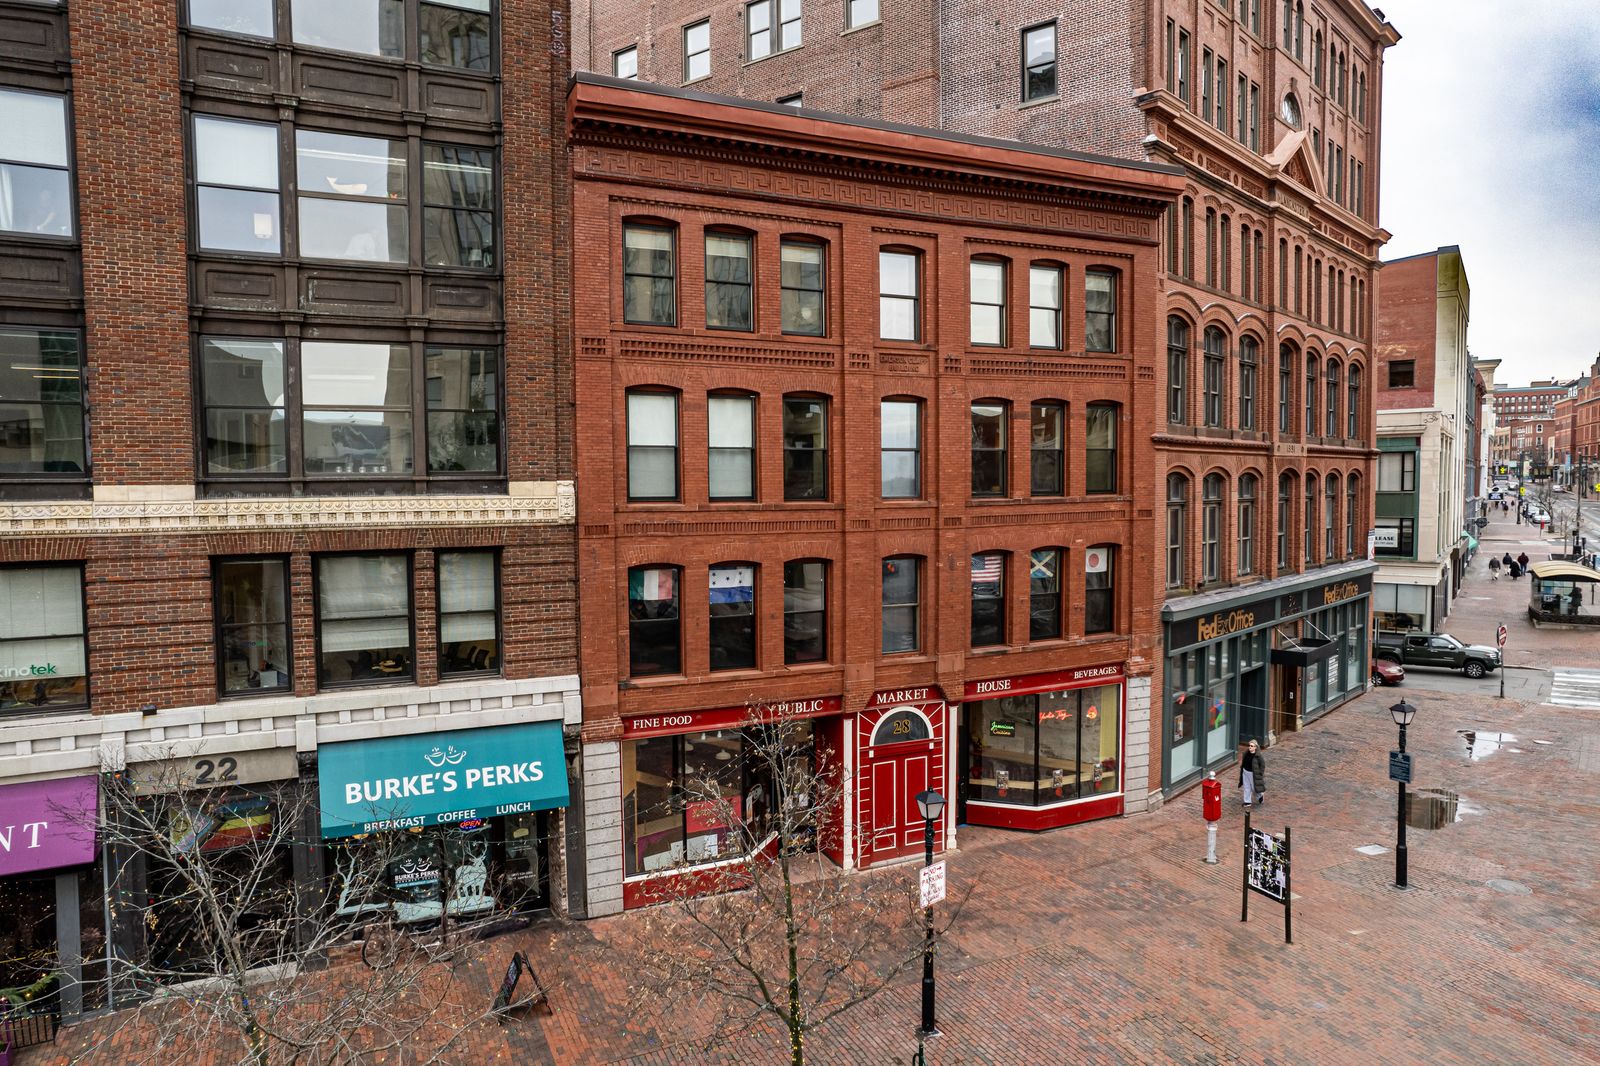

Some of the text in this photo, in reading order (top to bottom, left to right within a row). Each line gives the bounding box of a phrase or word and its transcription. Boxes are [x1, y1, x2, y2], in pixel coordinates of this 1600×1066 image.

[1228, 609, 1254, 632] Office
[1074, 666, 1117, 679] BEVERAGES
[976, 679, 1011, 693] HOUSE
[876, 688, 929, 704] MARKET
[778, 699, 824, 716] PUBLIC
[633, 715, 693, 730] FINE FOOD
[893, 719, 911, 735] 28
[195, 757, 238, 784] 22
[345, 761, 544, 805] BURKE'S PERKS
[496, 801, 531, 815] LUNCH
[436, 809, 477, 823] COFFEE
[364, 815, 426, 833] BREAKFAST
[460, 820, 481, 829] OPEN
[394, 872, 420, 881] BURKE'S
[420, 869, 439, 878] PERKS
